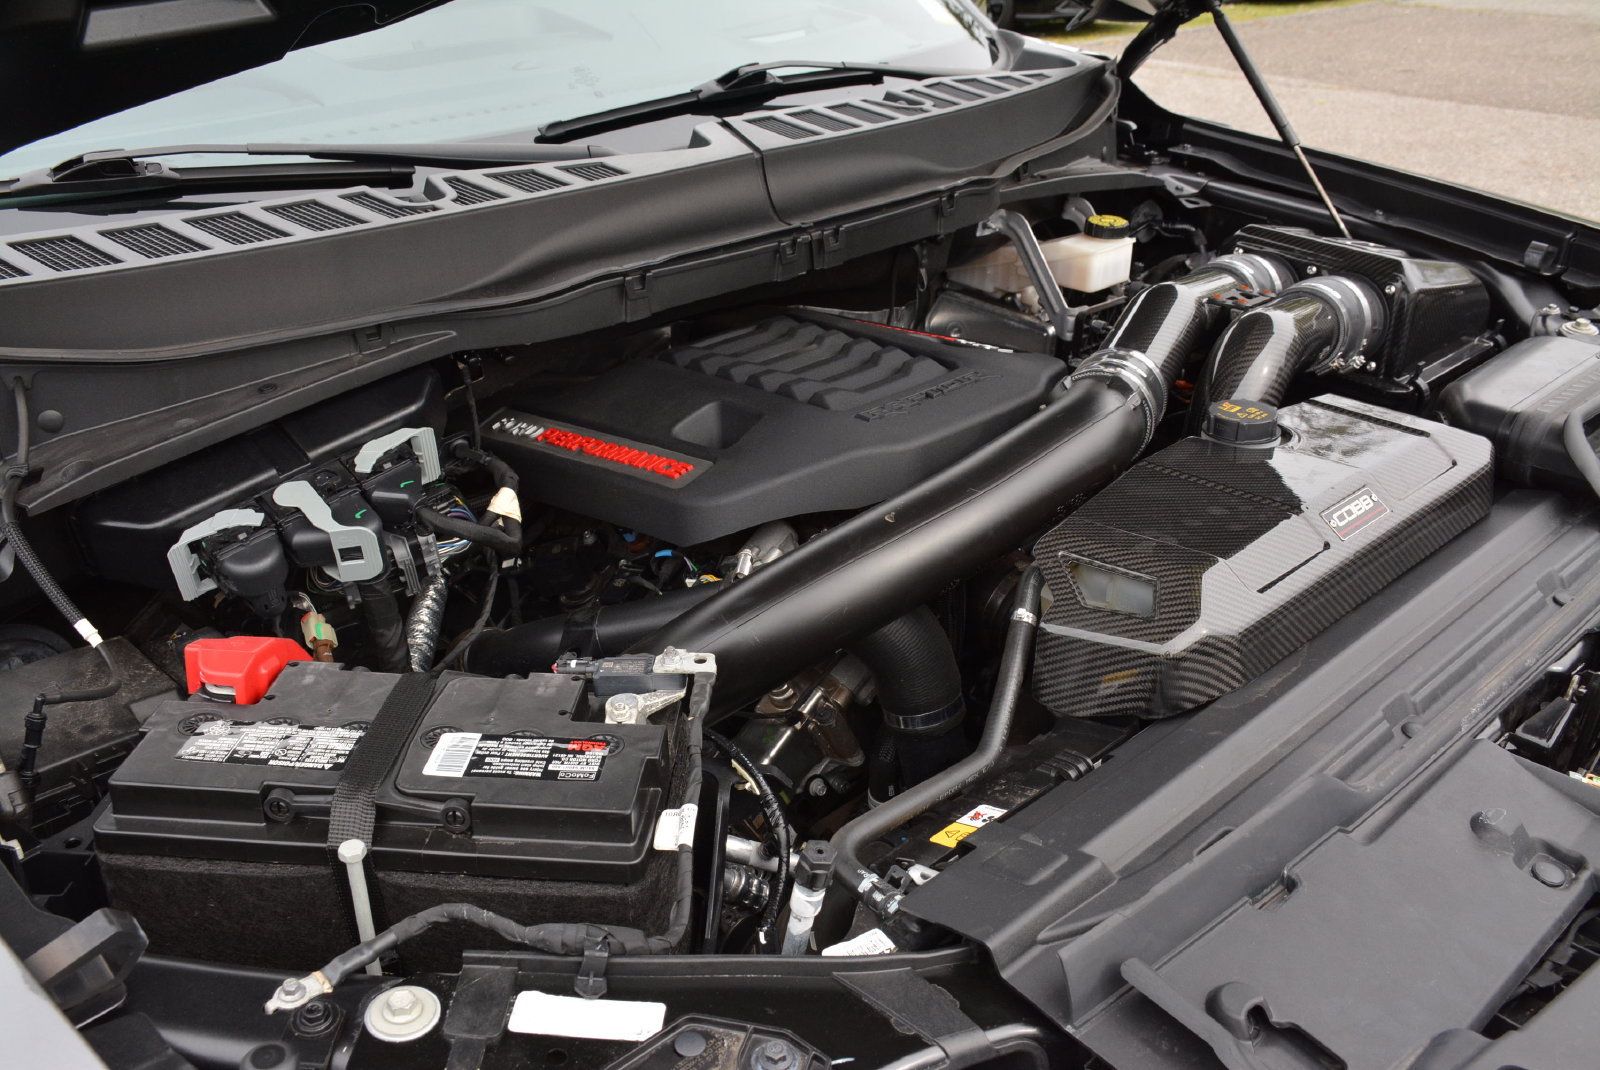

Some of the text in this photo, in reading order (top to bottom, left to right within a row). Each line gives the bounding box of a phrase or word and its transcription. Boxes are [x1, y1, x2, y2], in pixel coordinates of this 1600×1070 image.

[536, 427, 695, 479] PERFORMANCE
[1332, 494, 1374, 527] COBB
[567, 743, 605, 752] AGM
